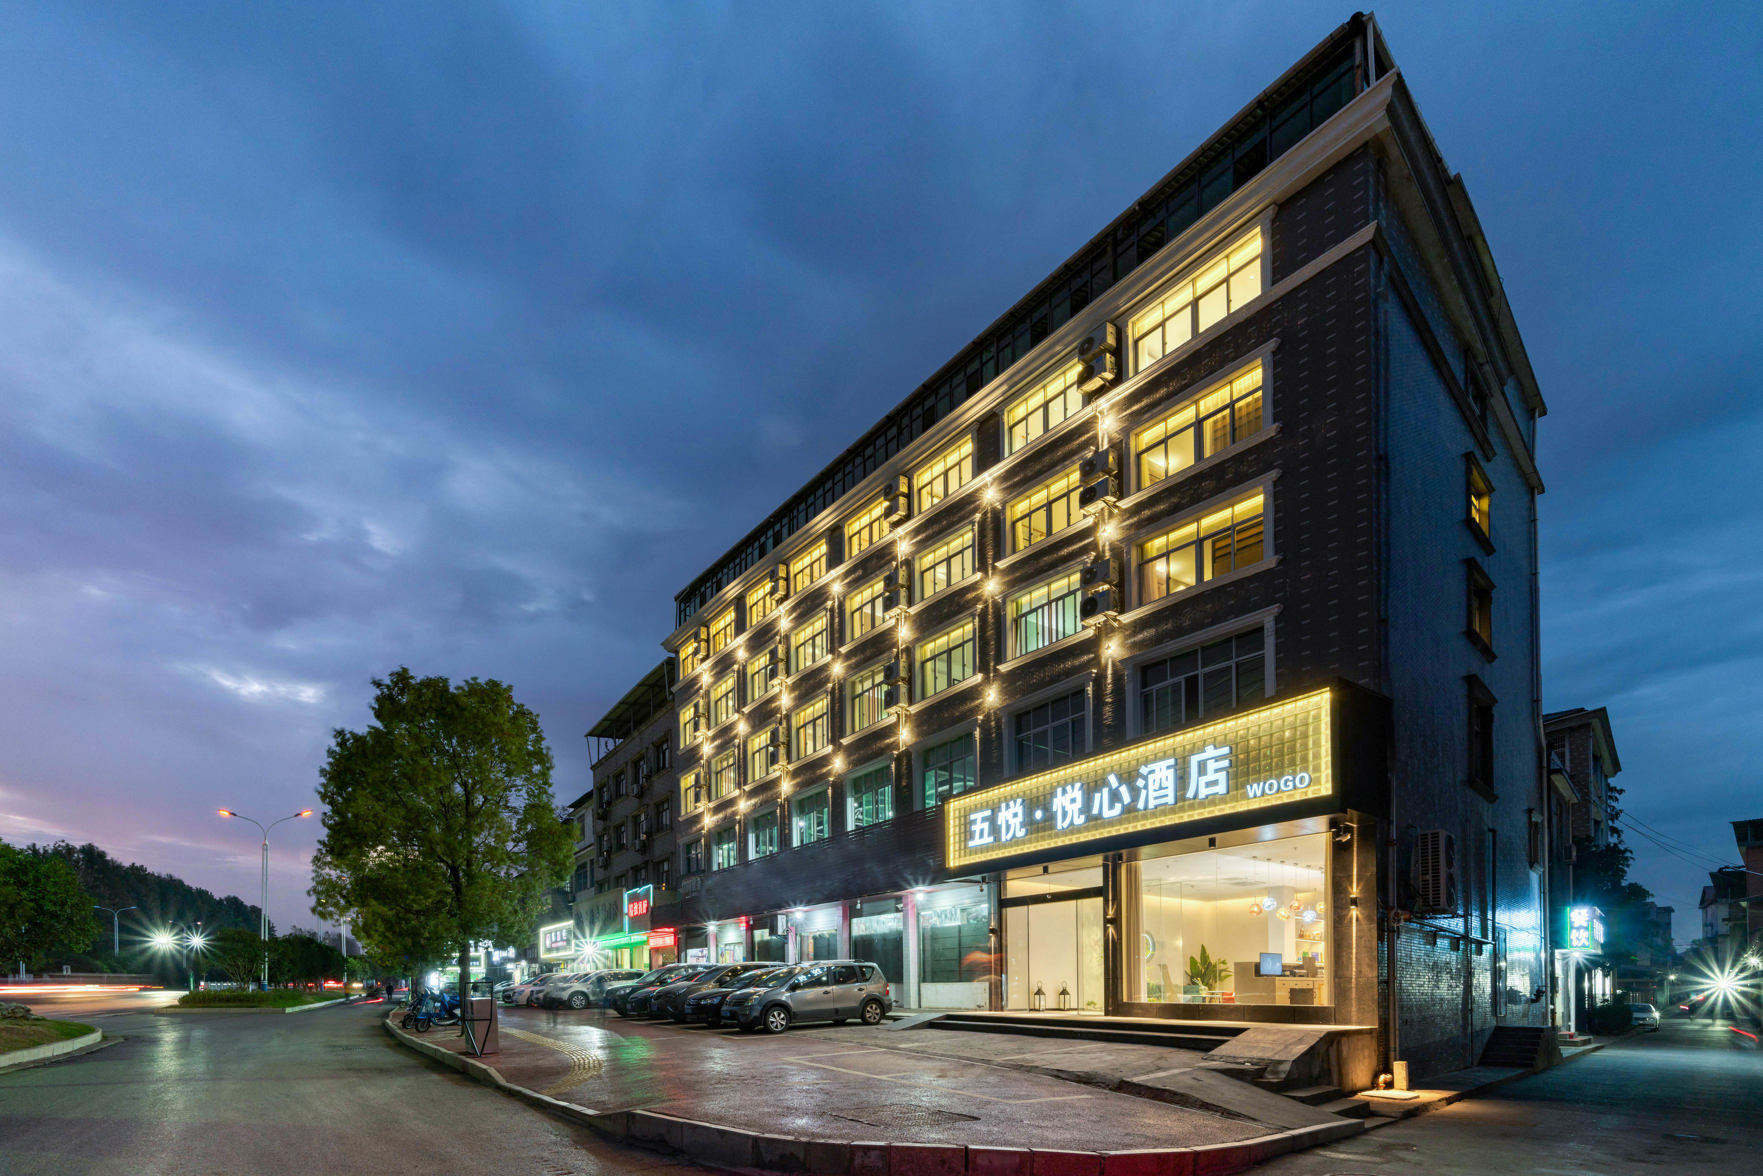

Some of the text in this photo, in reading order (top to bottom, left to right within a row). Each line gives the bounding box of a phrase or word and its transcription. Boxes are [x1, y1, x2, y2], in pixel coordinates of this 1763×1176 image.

[968, 744, 1232, 848] 五悦·悦心酒店
[1246, 772, 1312, 798] WOGO
